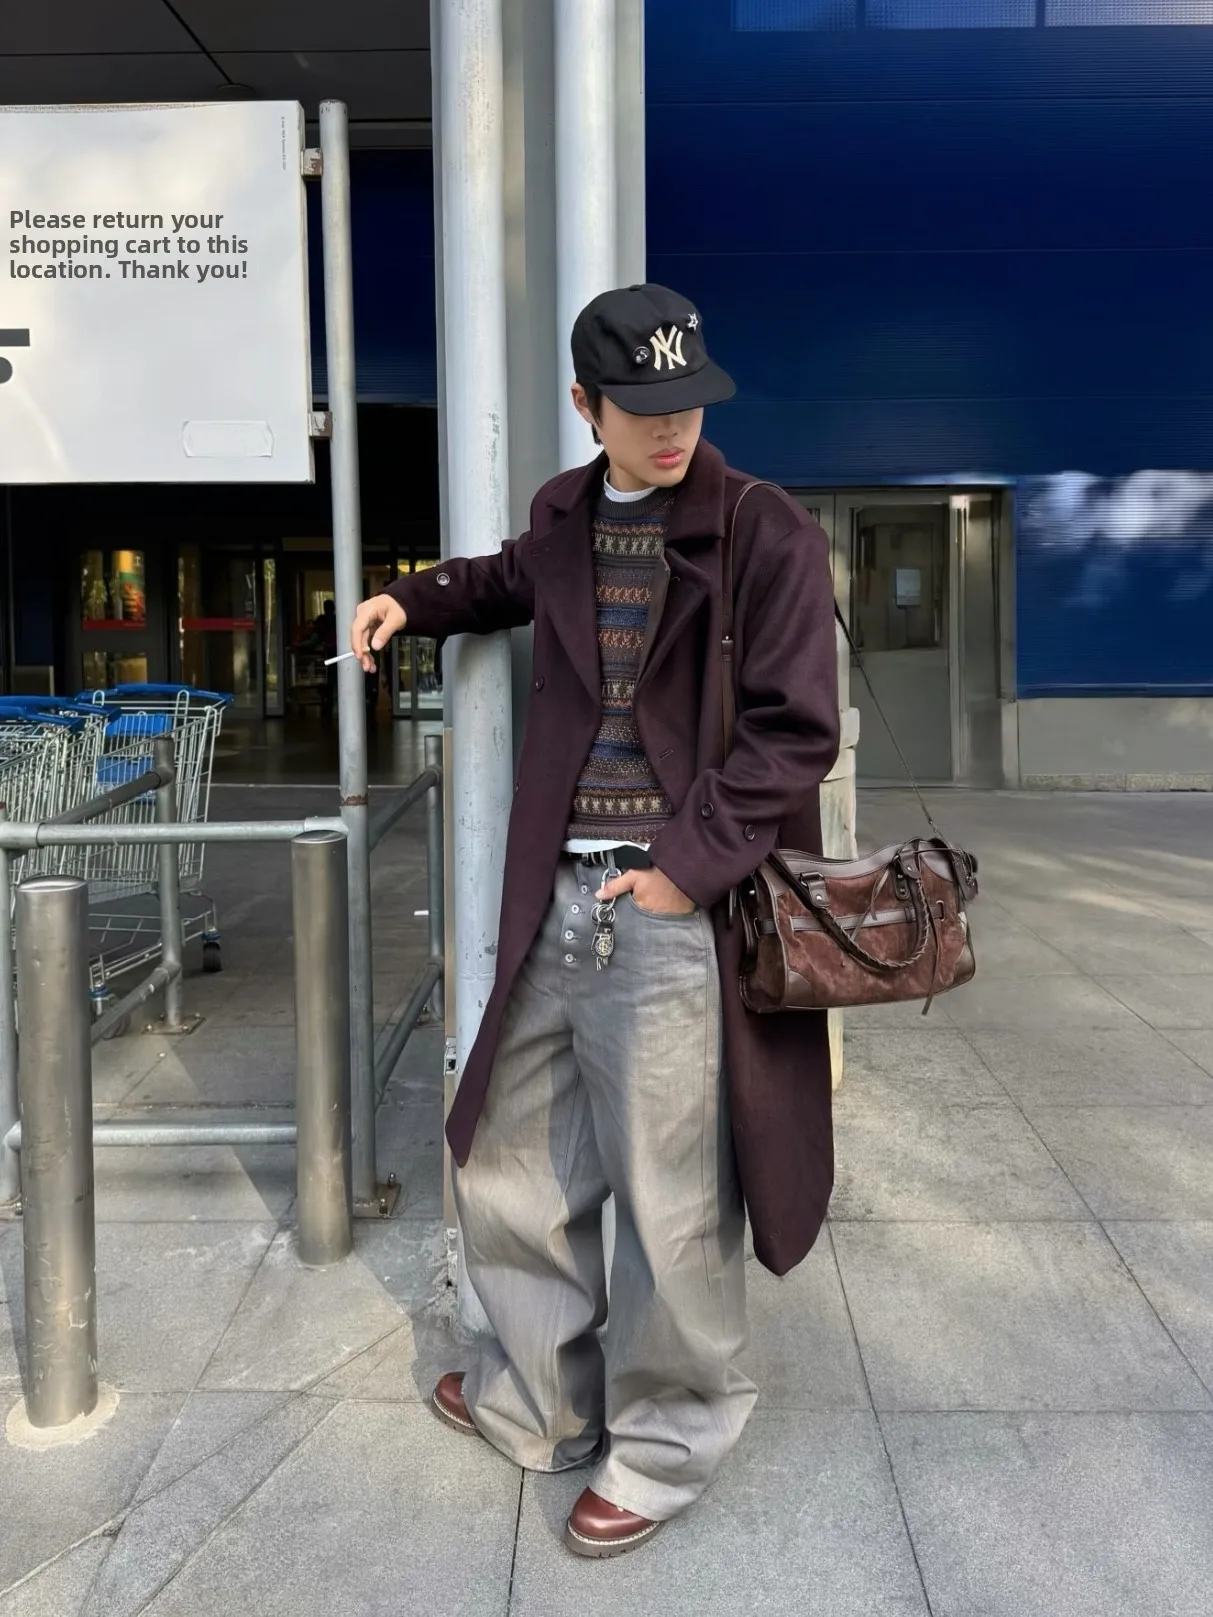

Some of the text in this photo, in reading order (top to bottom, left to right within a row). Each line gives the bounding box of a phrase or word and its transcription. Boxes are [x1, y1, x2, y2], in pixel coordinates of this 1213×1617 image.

[10, 210, 224, 233] Please return your
[10, 235, 249, 258] shopping cart to this
[10, 260, 248, 283] location. Thank you!
[649, 325, 687, 371] NY
